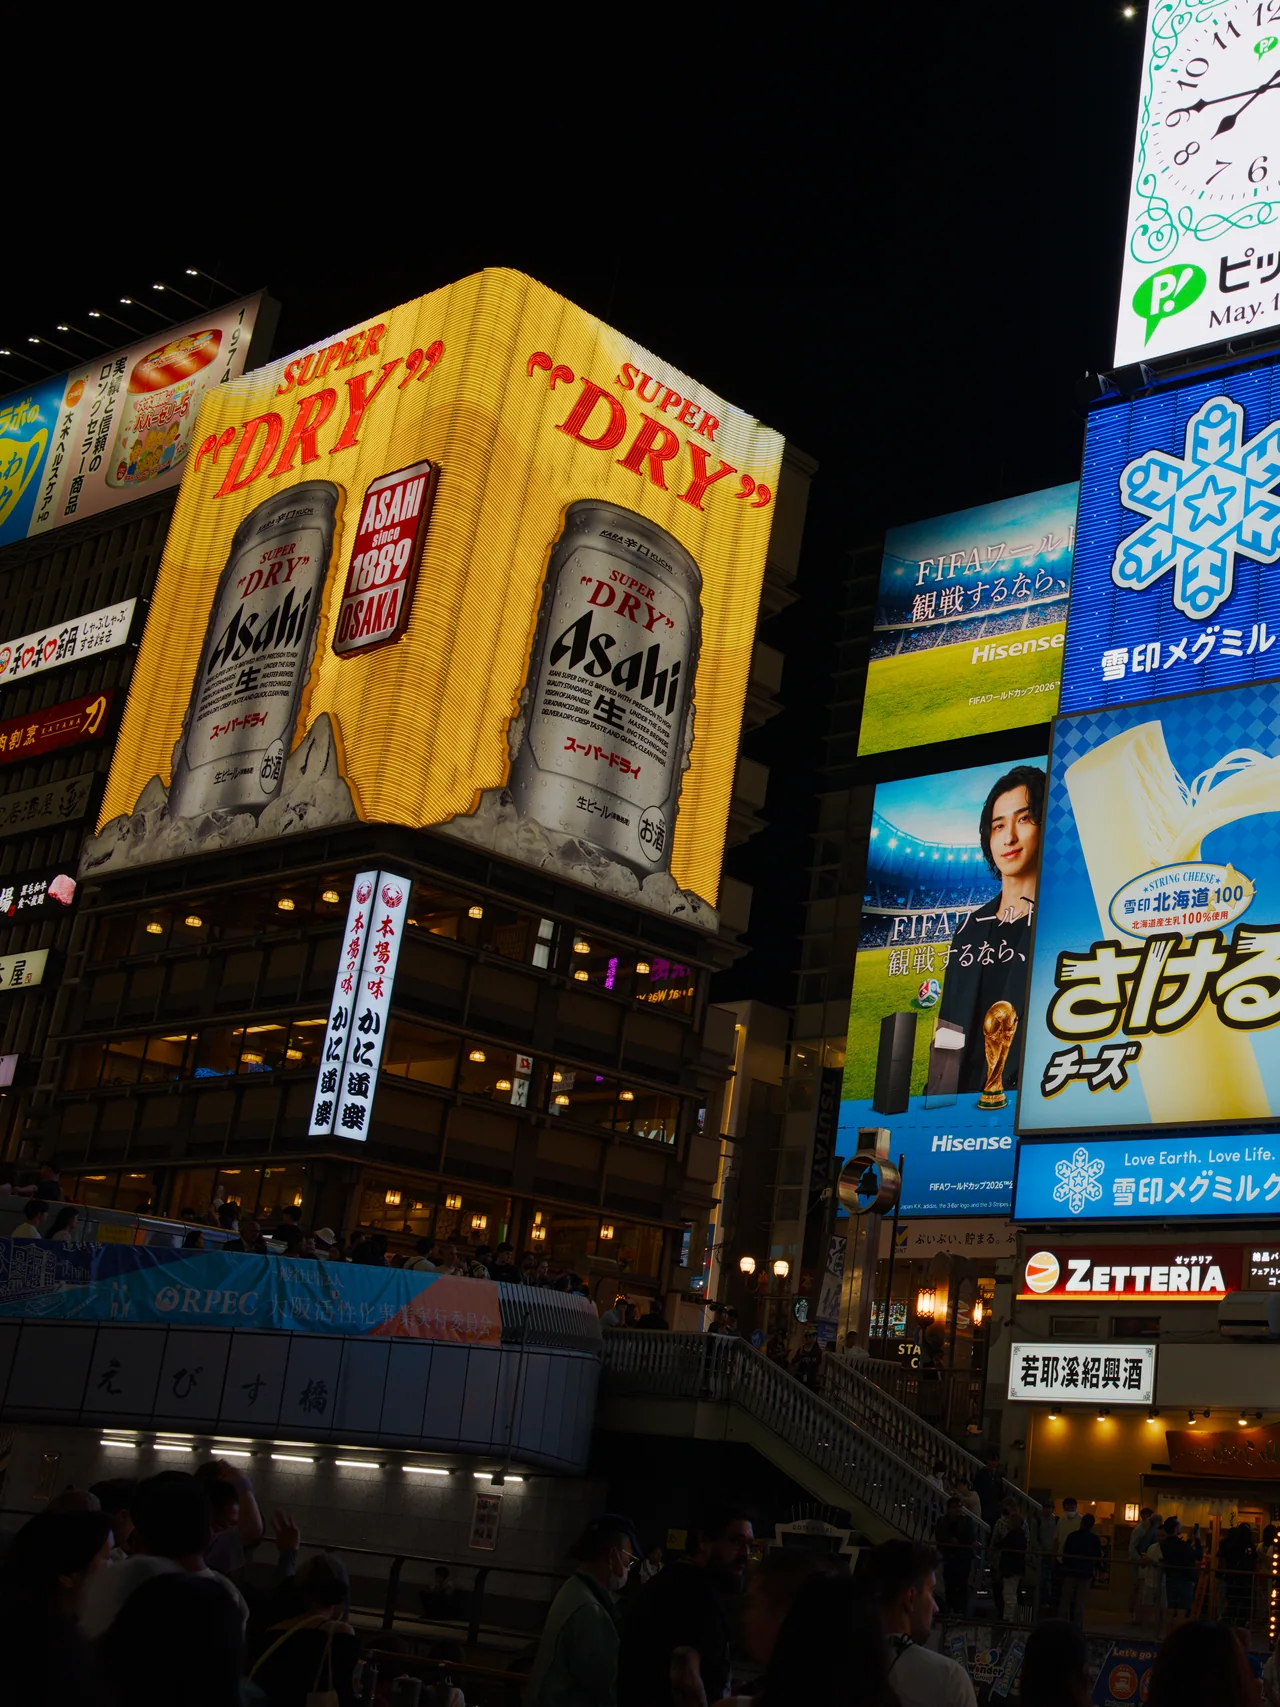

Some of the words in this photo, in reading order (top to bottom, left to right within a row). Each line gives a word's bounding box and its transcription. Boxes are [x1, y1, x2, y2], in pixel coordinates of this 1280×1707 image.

[1211, 20, 1241, 50] 11
[1177, 57, 1209, 91] 10
[1173, 141, 1200, 166] 8
[1247, 156, 1268, 183] 6
[1206, 159, 1233, 185] 7
[1209, 301, 1265, 329] May.
[275, 323, 386, 398] SUPER
[615, 362, 720, 442] SUPER
[64, 362, 114, 517] ロングセラー商品
[360, 477, 426, 535] ASAHI
[260, 542, 296, 564] SUPER
[371, 527, 400, 547] since
[600, 530, 624, 543] KARA
[650, 552, 673, 571] KUCHI
[350, 538, 412, 593] 1889
[609, 570, 656, 601] SUPER
[912, 568, 1066, 624] 観戦するなら、
[208, 586, 312, 675] Asahi
[337, 587, 399, 644] OSAKA
[550, 610, 681, 716] Asahi
[971, 634, 1066, 665] Hisense
[234, 666, 261, 696] 生
[561, 671, 577, 680] SUPER
[594, 681, 618, 696] BREWED
[617, 692, 631, 703] WITH
[80, 696, 107, 734] 刀
[209, 712, 269, 740] スーパードライ
[593, 694, 627, 731] 生
[628, 719, 650, 732] MASTER
[564, 737, 642, 780] スーパードライ
[1148, 873, 1181, 891] STRING
[1182, 871, 1217, 885] CHEESE
[1131, 911, 1228, 929] 北海道産生乳100%使用
[341, 911, 365, 996] 本場の味
[367, 914, 395, 1001] 本場の味
[888, 939, 1026, 977] 観戦するなら、
[1042, 1043, 1139, 1095] チーズ
[813, 1082, 834, 1183] TSUTAY
[931, 1135, 1012, 1152] Hisense
[1124, 1152, 1156, 1166] Love
[1159, 1150, 1202, 1165] Earth.
[1208, 1149, 1241, 1163] Love
[1245, 1147, 1276, 1162] Life.
[1065, 1259, 1226, 1291] ZETTERIA
[1175, 1256, 1212, 1264] ゼッテリア
